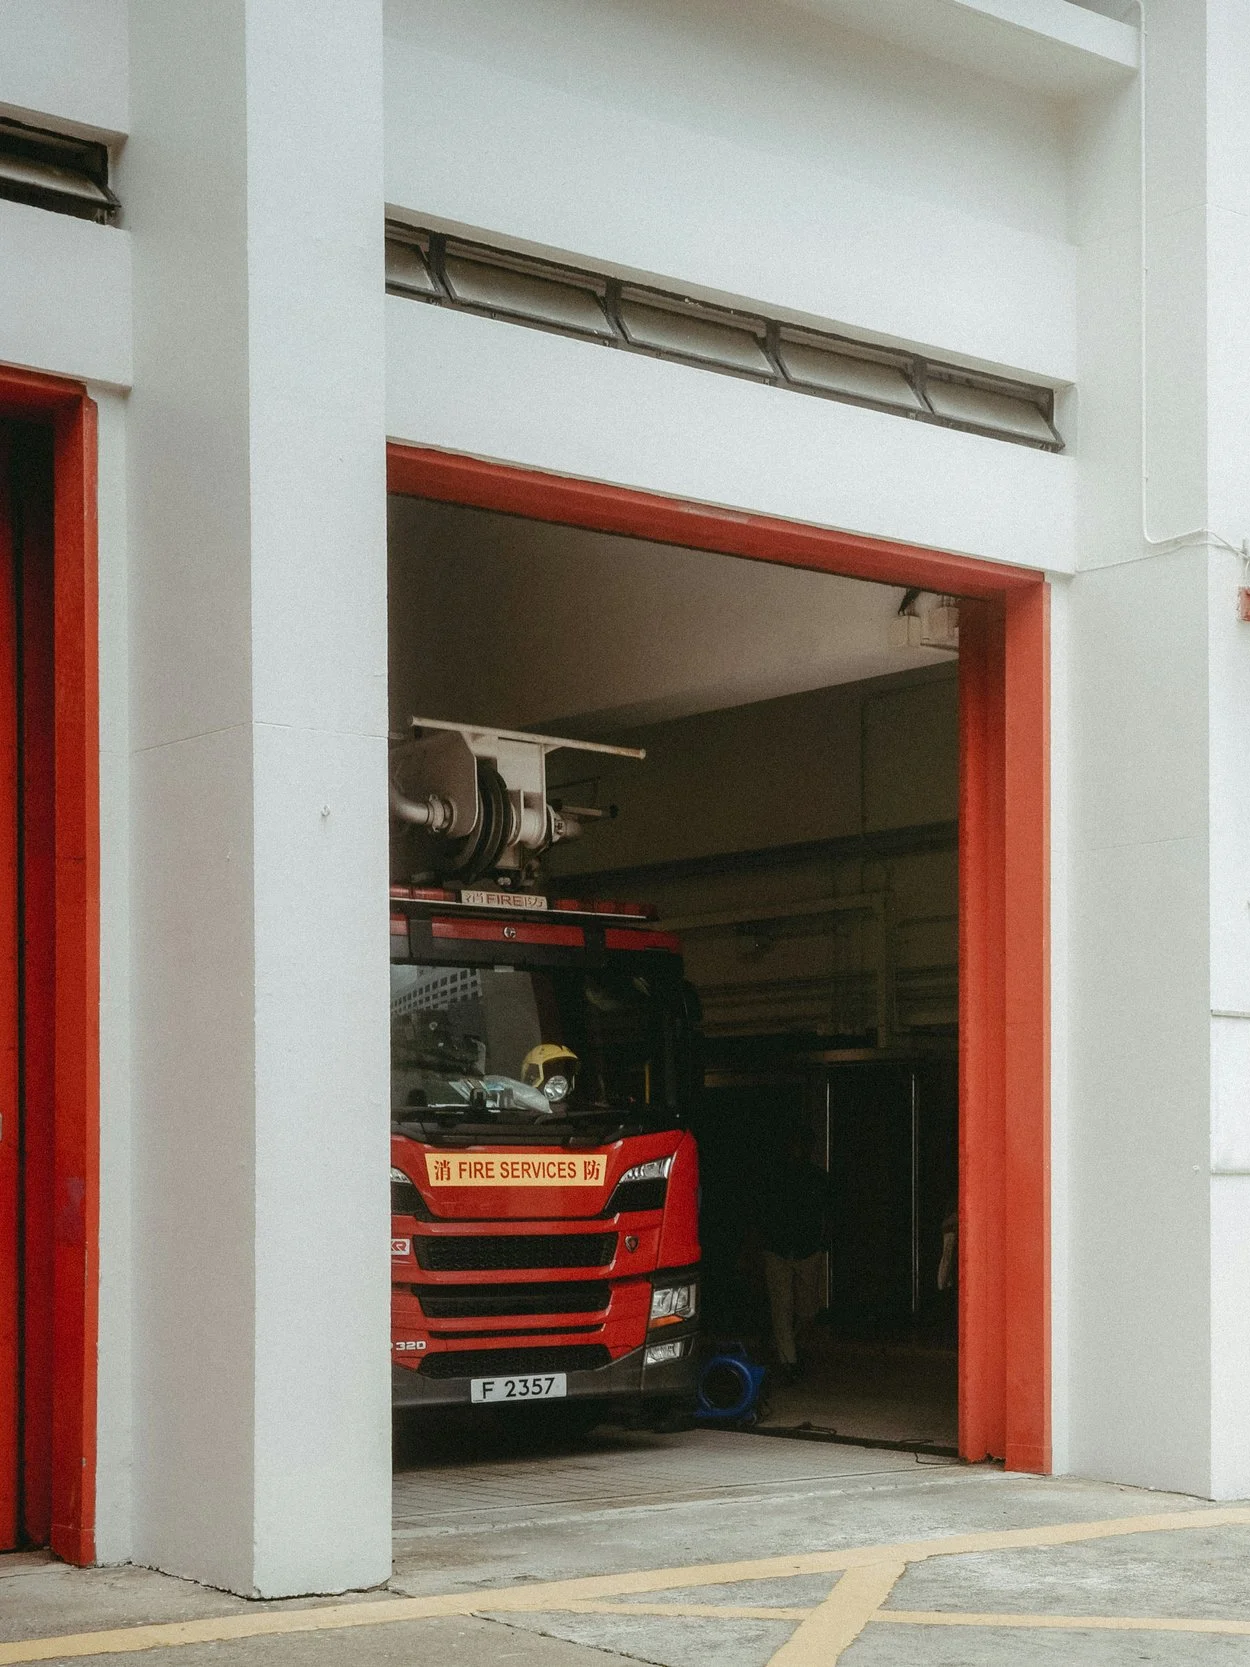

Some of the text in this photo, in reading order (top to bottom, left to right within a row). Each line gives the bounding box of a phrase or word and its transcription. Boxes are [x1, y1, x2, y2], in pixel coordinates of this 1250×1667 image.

[486, 894, 522, 906] FIRE
[434, 1159, 600, 1181] 消 FIRE SERVICES 防
[482, 1377, 555, 1399] F 2357
